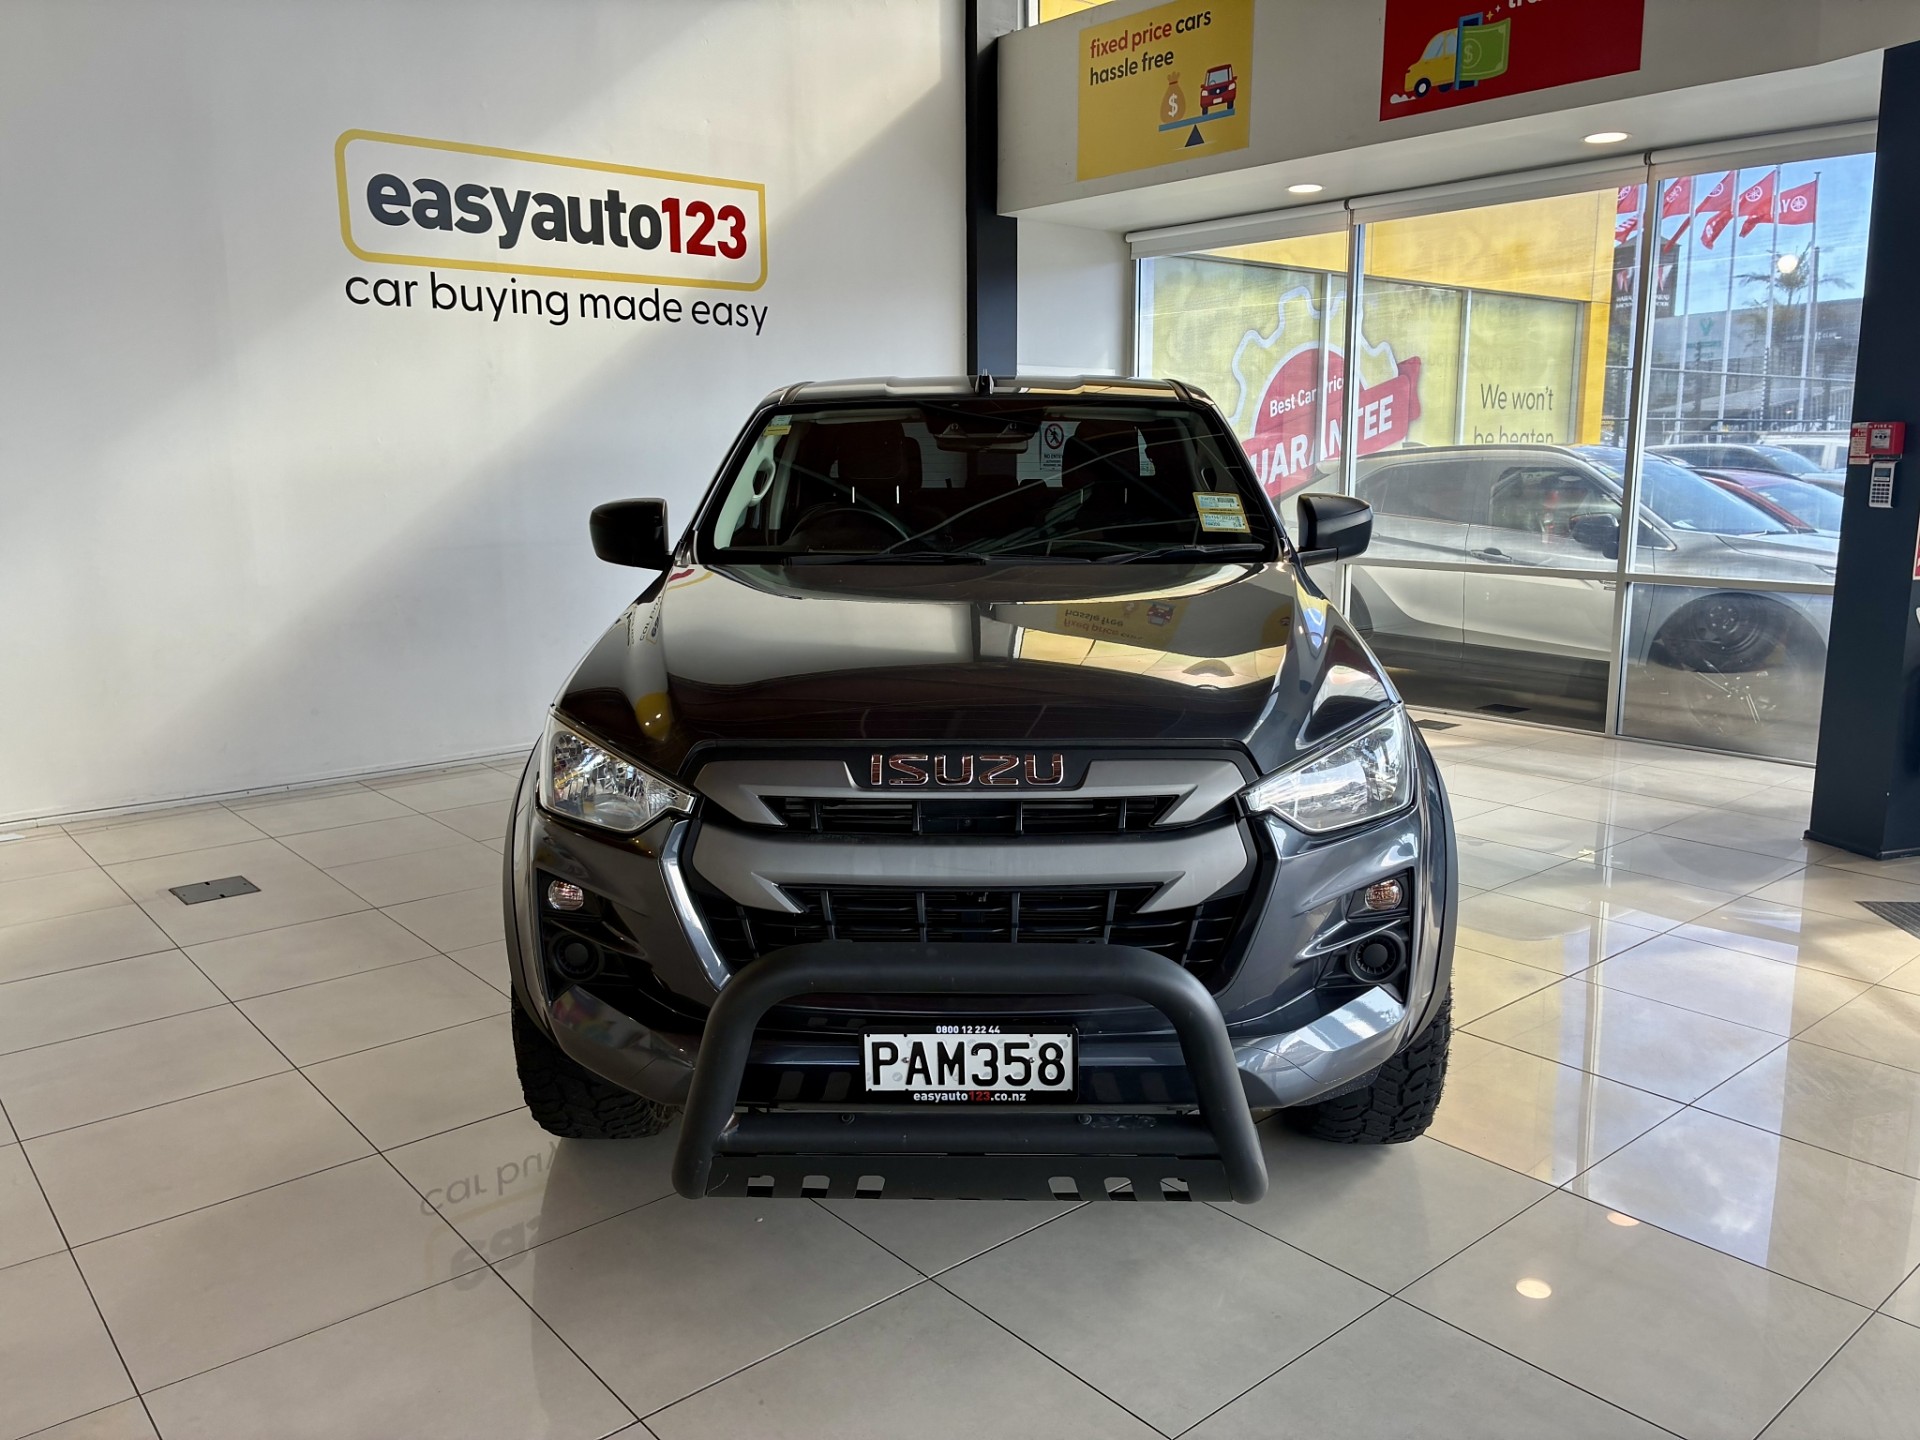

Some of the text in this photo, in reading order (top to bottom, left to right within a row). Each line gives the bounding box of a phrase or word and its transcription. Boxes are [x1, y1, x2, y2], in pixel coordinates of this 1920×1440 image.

[1090, 10, 1212, 58] fixed price cars
[1090, 51, 1174, 86] hassle free
[1168, 93, 1178, 117] $
[366, 172, 747, 259] easyauto123
[345, 271, 769, 336] car buying made easy
[1269, 394, 1295, 418] Best
[1297, 388, 1317, 405] Car
[1480, 383, 1554, 411] We won't
[1251, 394, 1394, 486] UARNEE
[1499, 425, 1554, 444] beaten
[870, 754, 1064, 786] ISUZU
[935, 1025, 1001, 1034] 0800 12 22 44
[871, 1041, 1066, 1087] PAM358
[913, 1091, 1026, 1103] easyauto123.co.nz
